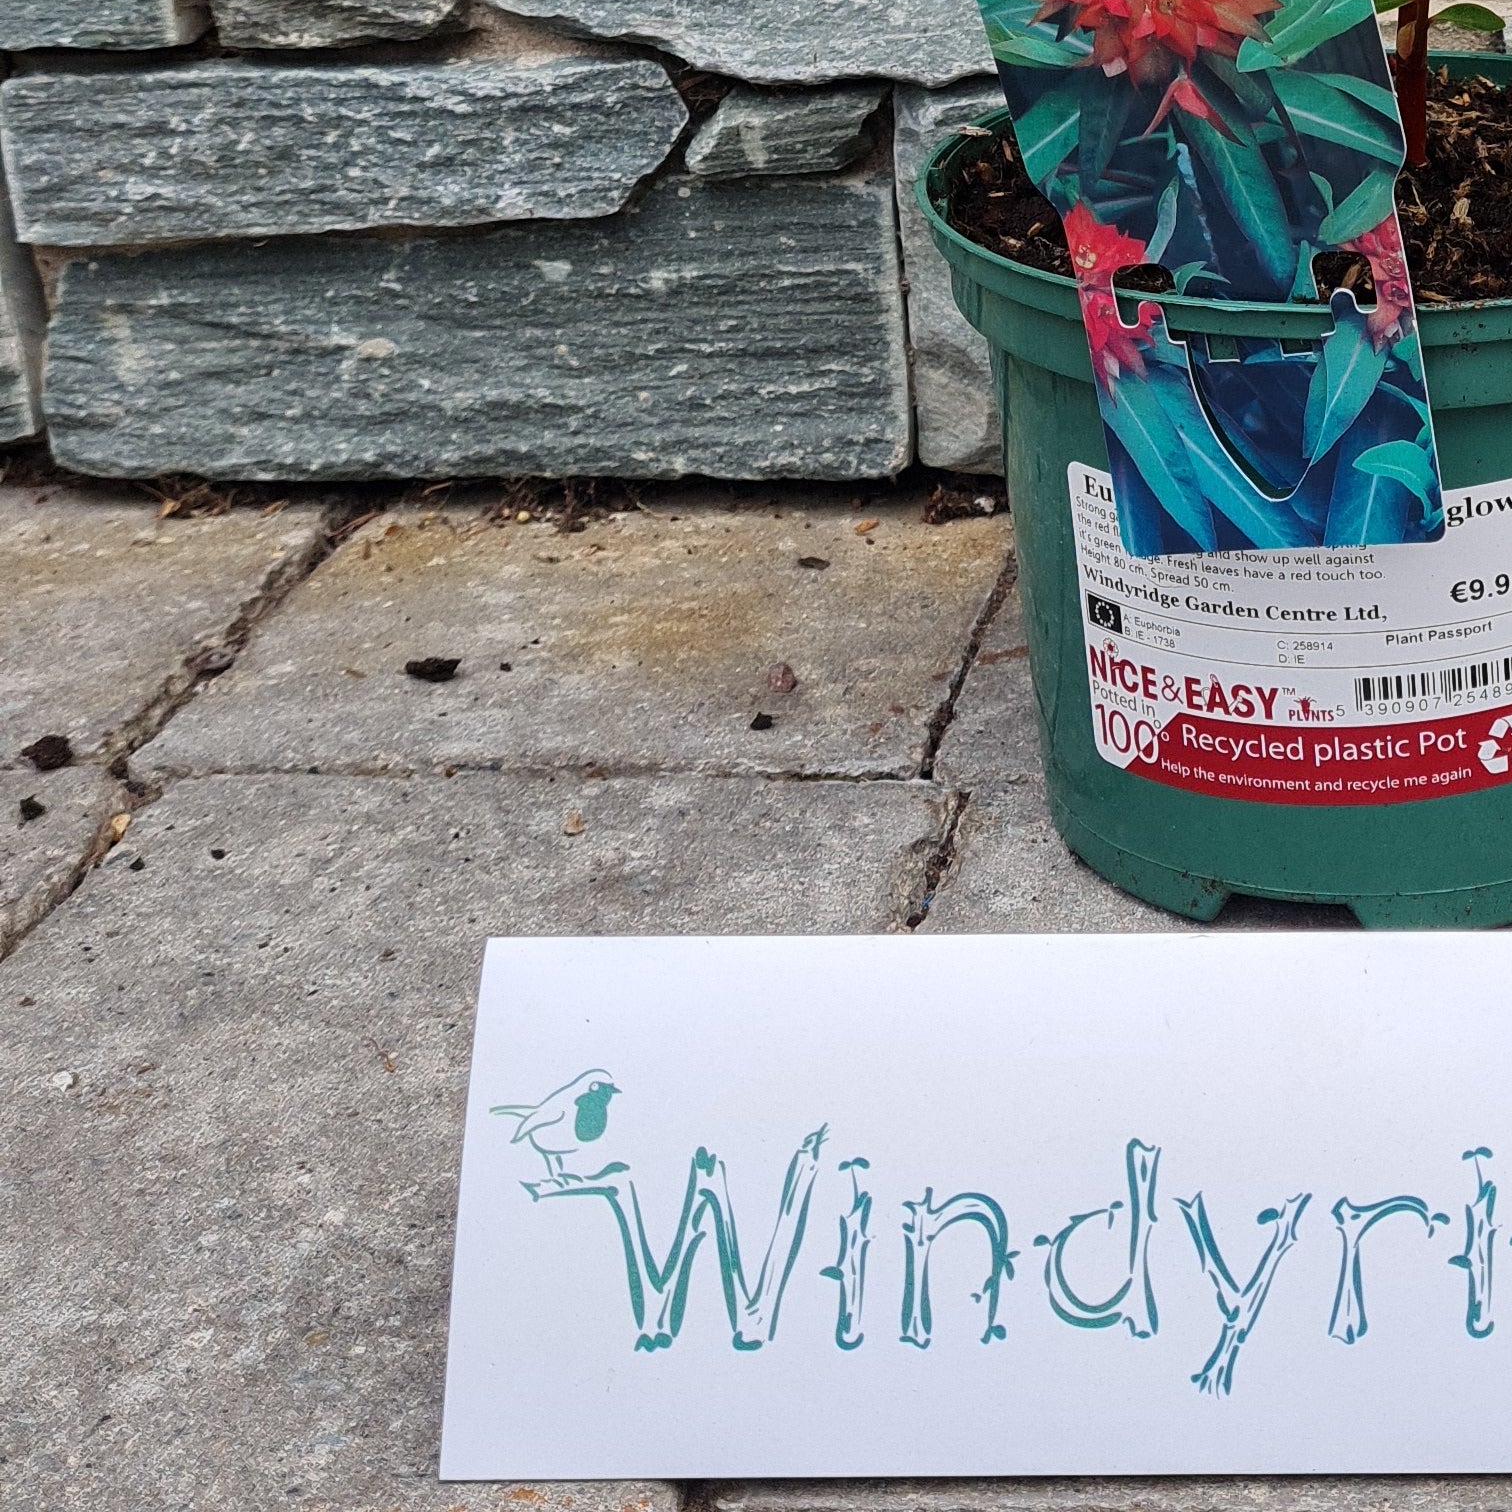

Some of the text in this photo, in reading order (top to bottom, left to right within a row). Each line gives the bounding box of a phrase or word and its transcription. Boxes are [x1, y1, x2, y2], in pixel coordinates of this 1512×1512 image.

[1076, 496, 1107, 519] Strong
[1077, 512, 1092, 527] the
[1094, 521, 1110, 534] red
[1080, 543, 1111, 566] Height
[1113, 558, 1126, 570] 80
[1150, 567, 1190, 586] Spread
[1194, 576, 1208, 588] 50
[1212, 581, 1235, 593] cm.
[1094, 537, 1121, 553] green
[1167, 555, 1198, 572] Fresh
[1201, 561, 1240, 577] leaves
[1243, 567, 1274, 580] have
[1277, 571, 1286, 580] a
[1290, 569, 1312, 581] red
[1315, 568, 1355, 581] touch
[1359, 569, 1386, 580] too.
[1234, 550, 1268, 563] show
[1273, 554, 1290, 567] up
[1293, 553, 1321, 565] well
[1325, 553, 1375, 567] against
[1082, 564, 1388, 622] Windyridge Garden Centre Ltd,
[1134, 616, 1182, 637] Euphorbia
[1385, 621, 1493, 646] Plant Passport
[1153, 635, 1176, 648] 1738
[1292, 641, 1334, 651] 258914
[1293, 654, 1305, 664] IE
[1092, 680, 1156, 719] Potted in
[1182, 723, 1304, 762] Recycled
[1314, 735, 1411, 767] plastic
[1419, 728, 1468, 755] Pot
[1161, 757, 1473, 794] Help the environment and recycle me again
